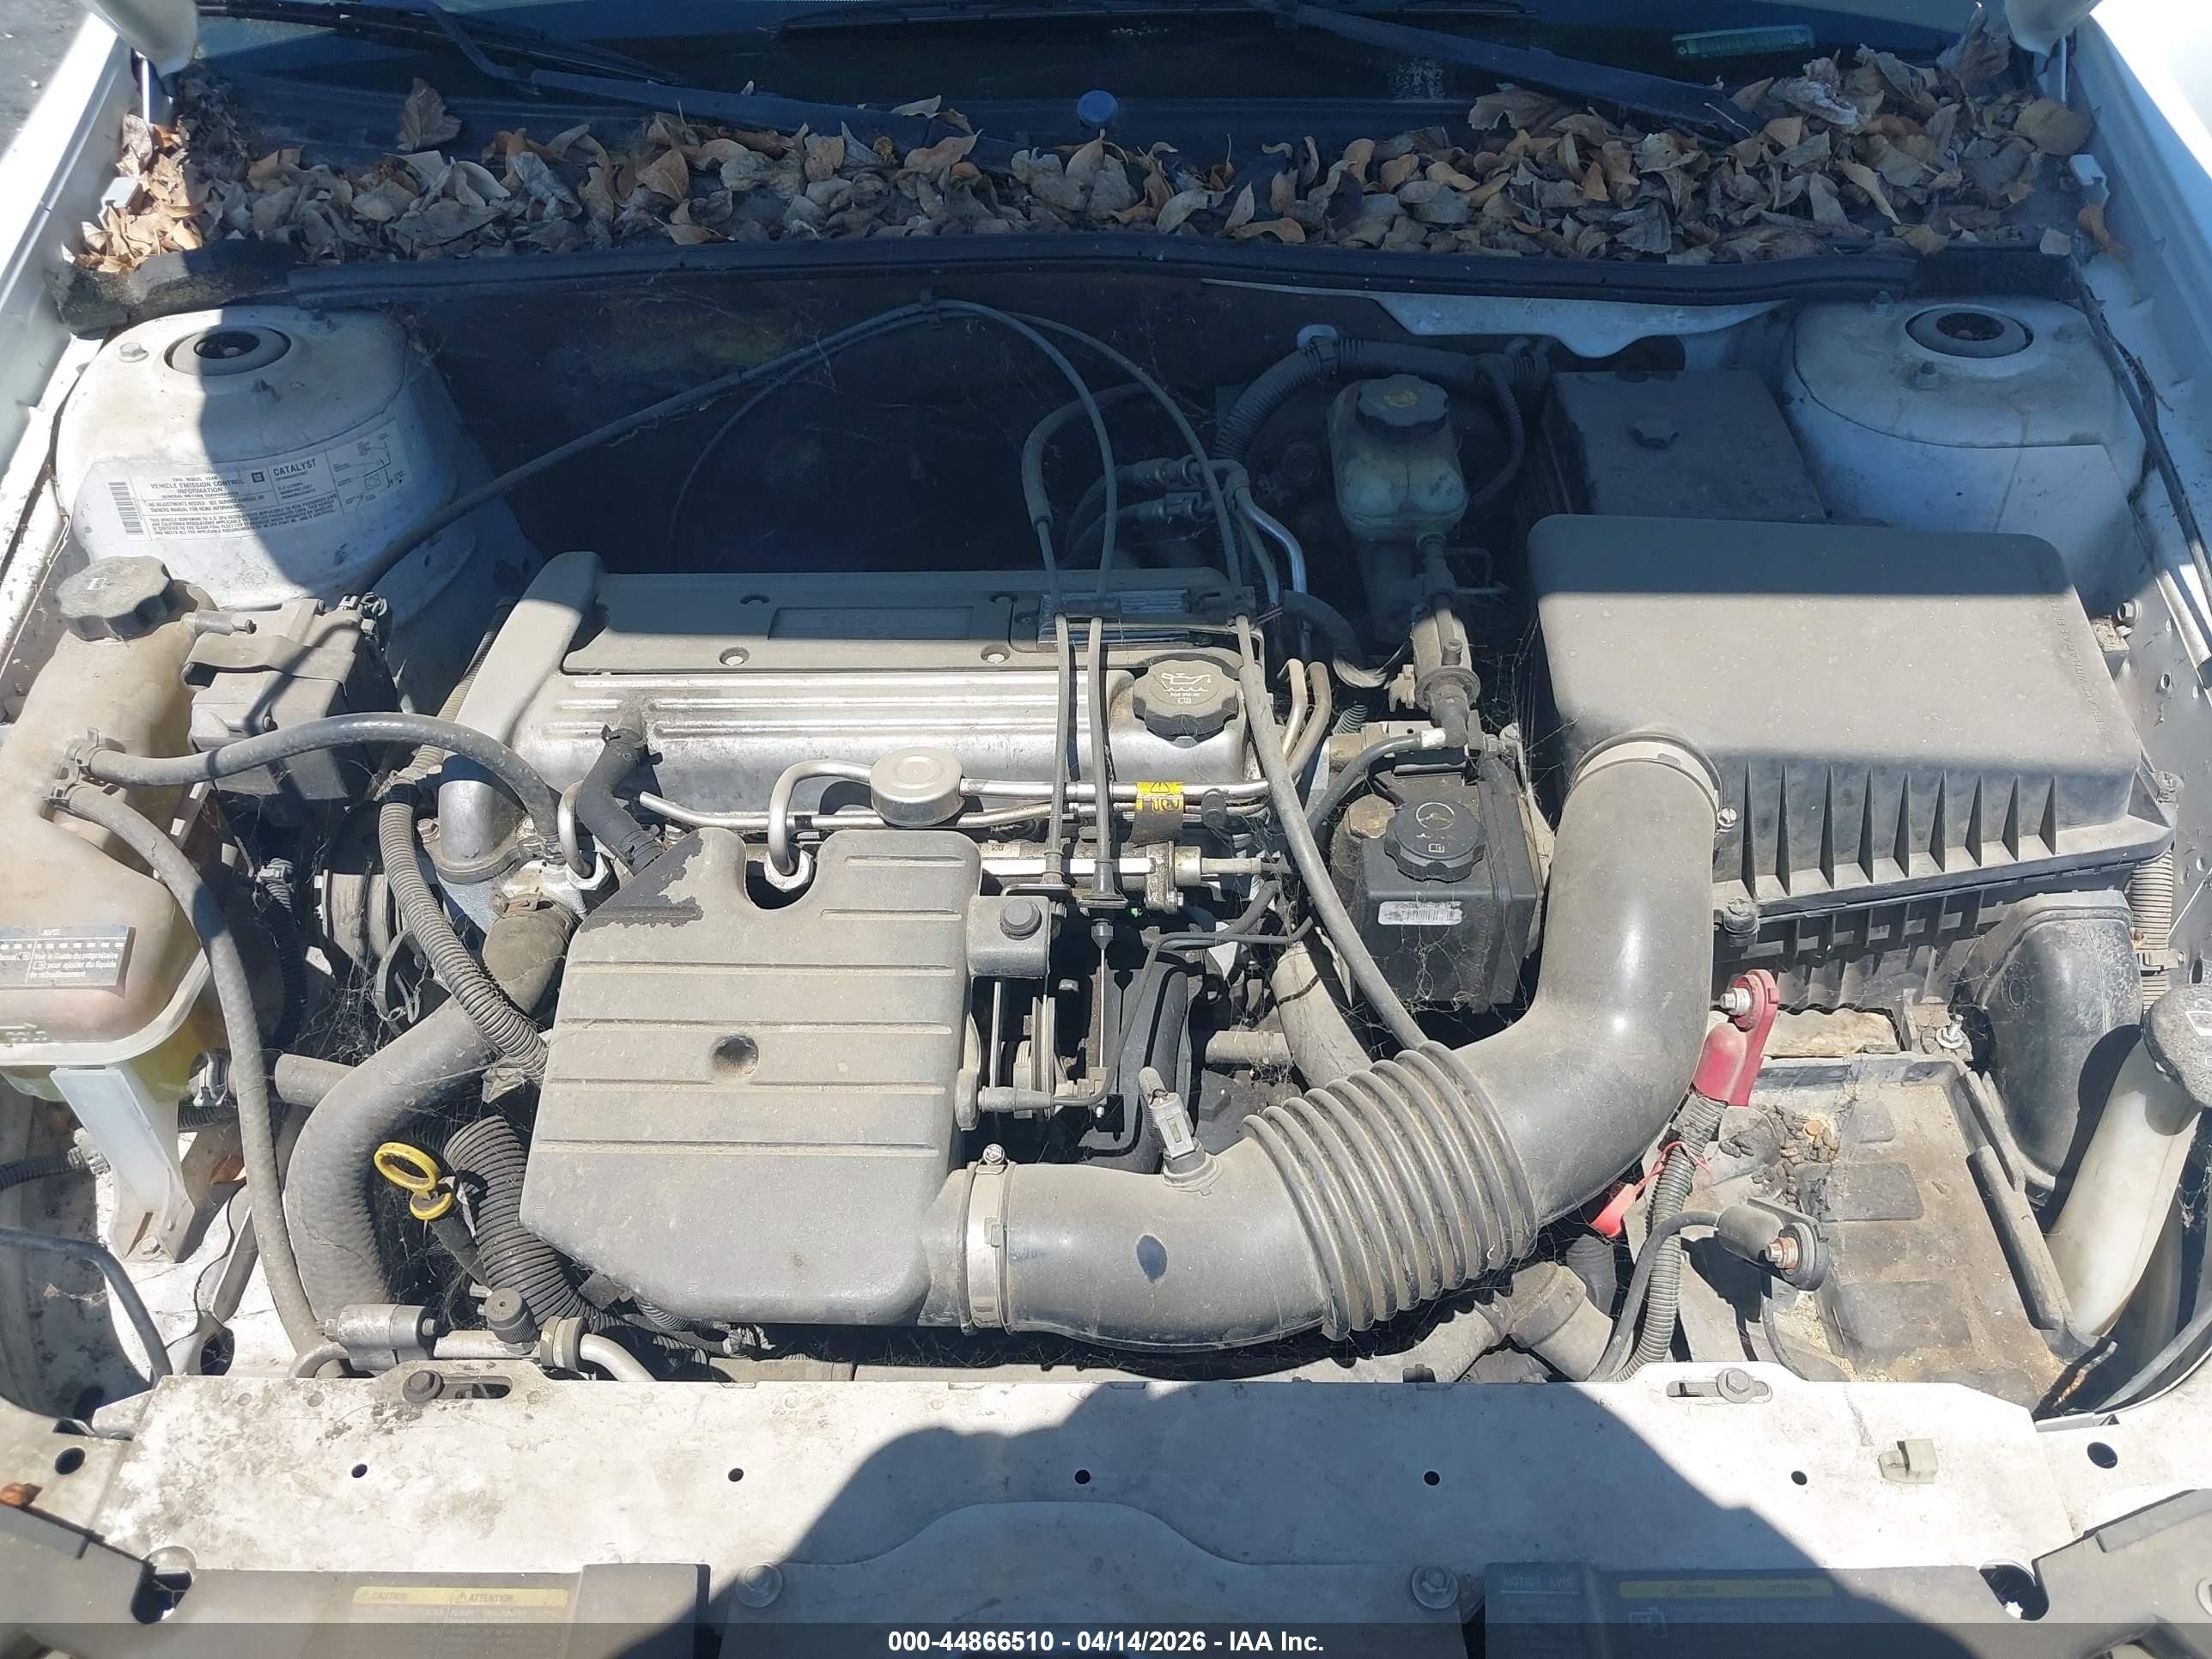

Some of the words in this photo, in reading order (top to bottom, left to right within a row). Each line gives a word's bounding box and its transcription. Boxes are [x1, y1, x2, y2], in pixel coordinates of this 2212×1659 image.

[273, 459, 317, 477] CATALYST
[95, 961, 117, 969] liquide
[1503, 1576, 1543, 1589] NOTICE
[1548, 1575, 1574, 1588] AVIS
[1678, 1585, 1716, 1595] CAUTION
[373, 1591, 410, 1601] CAUTION
[468, 1592, 514, 1602] ATTENTION
